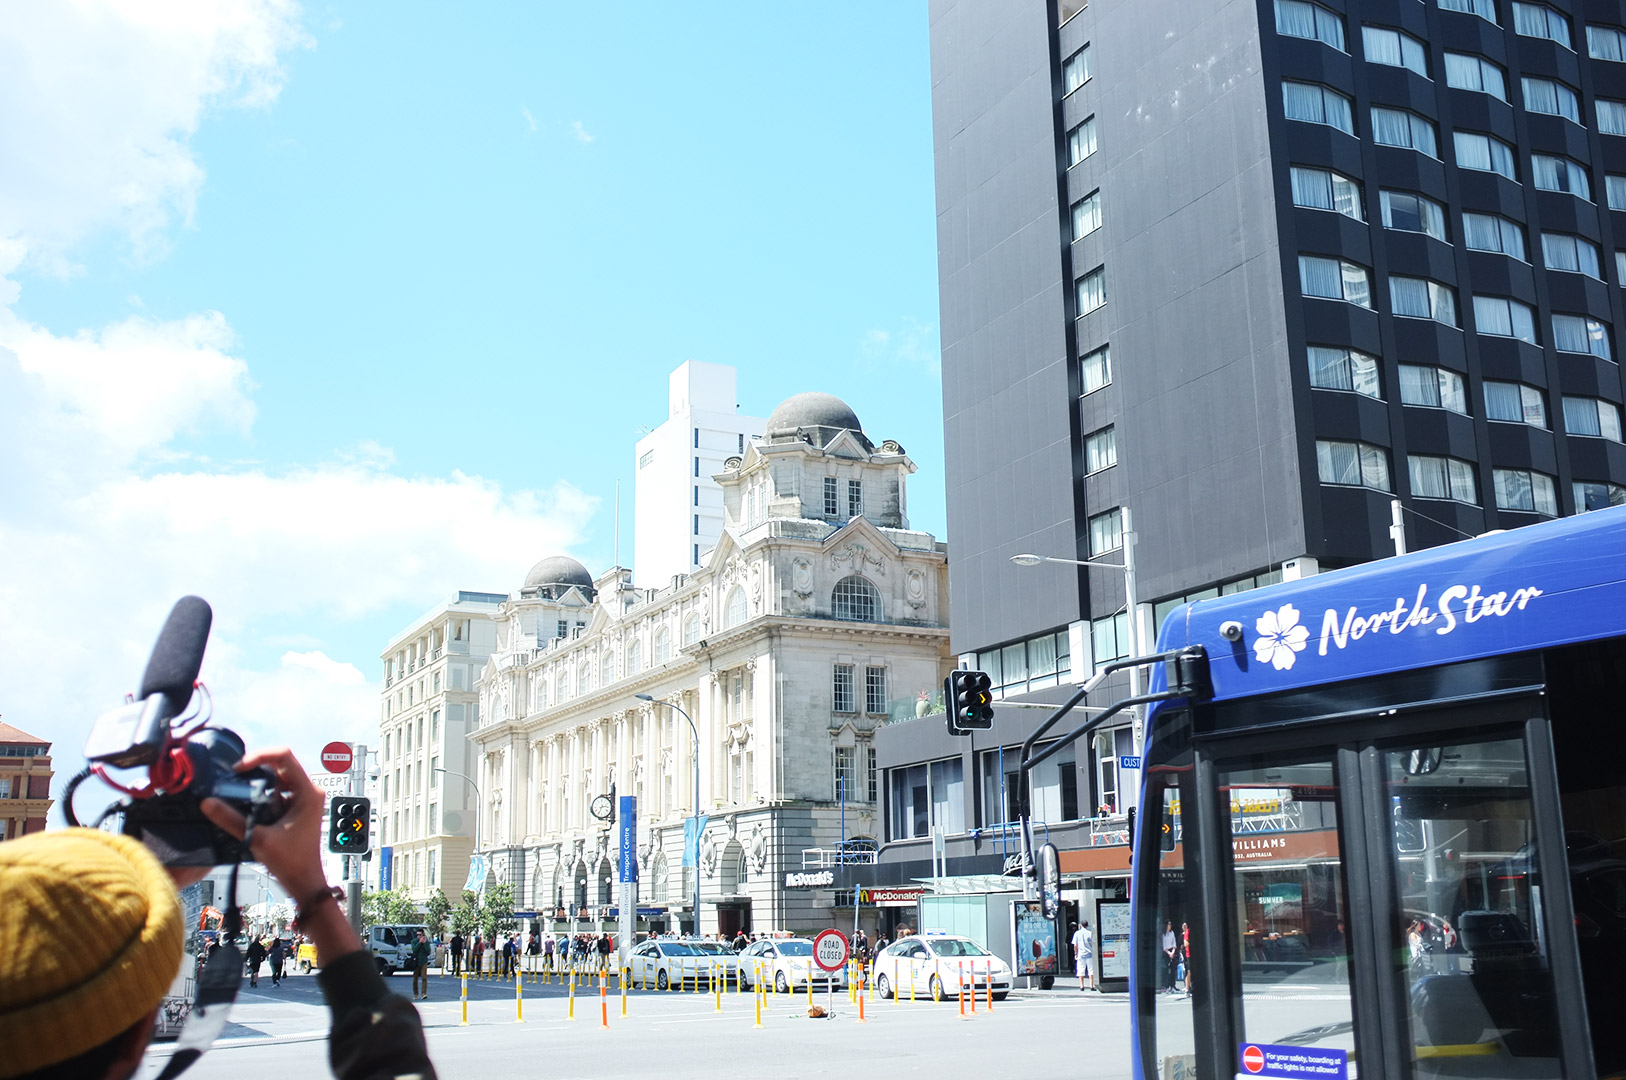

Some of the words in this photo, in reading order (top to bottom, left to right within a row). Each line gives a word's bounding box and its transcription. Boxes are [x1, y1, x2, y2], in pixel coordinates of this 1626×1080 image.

[623, 850, 631, 882] Transport
[786, 870, 834, 887] McDonald's
[823, 940, 840, 950] ROAD
[819, 951, 842, 960] CLOSED
[1266, 1052, 1276, 1060] For
[1276, 1054, 1289, 1062] your
[1308, 1055, 1334, 1066] boarding
[1334, 1057, 1342, 1065] at
[1266, 1062, 1283, 1070] traffic
[1283, 1063, 1299, 1072] lights
[1299, 1063, 1305, 1072] is
[1305, 1065, 1316, 1073] not
[1316, 1065, 1339, 1074] allowed
